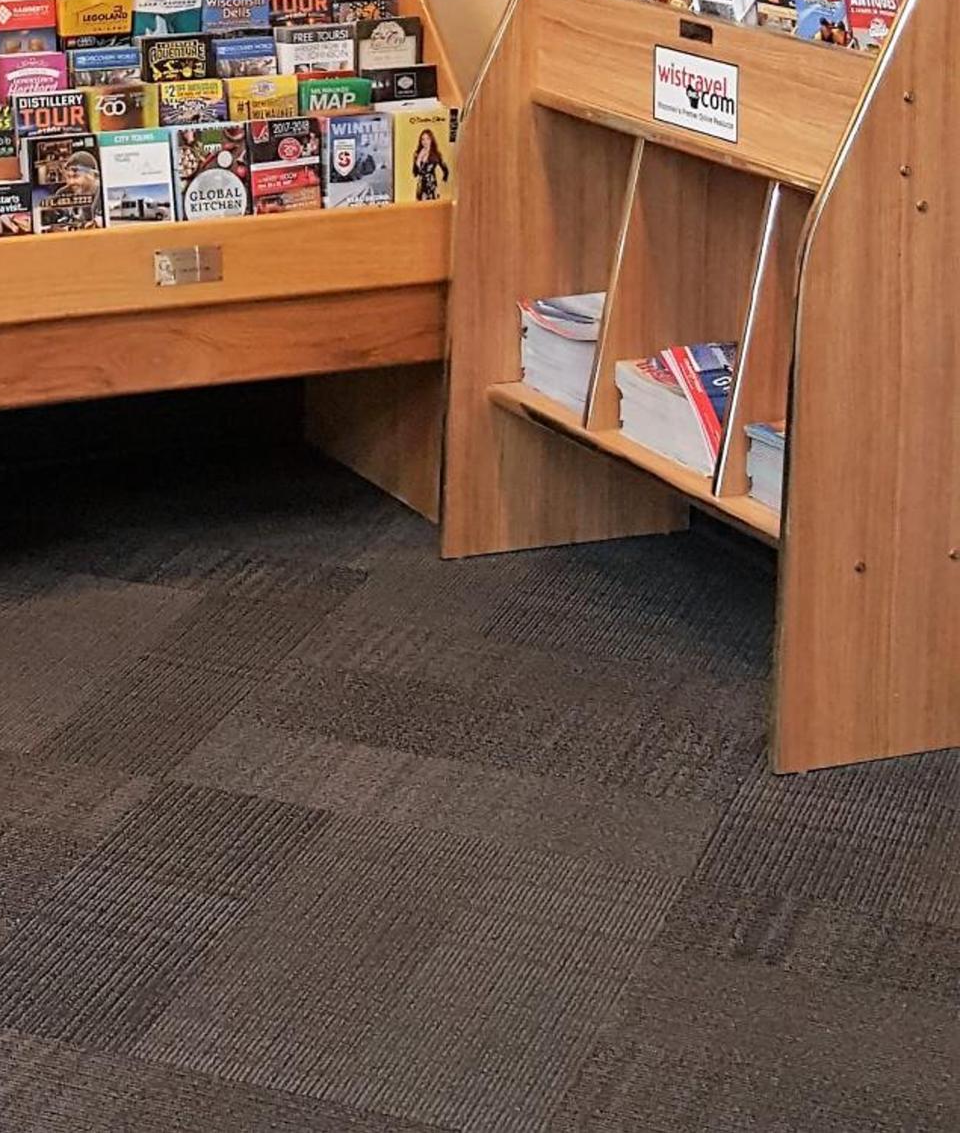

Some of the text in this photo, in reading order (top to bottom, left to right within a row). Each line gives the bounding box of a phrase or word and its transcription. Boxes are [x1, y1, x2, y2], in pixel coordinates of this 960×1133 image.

[83, 13, 128, 22] LEGOLAND
[223, 8, 251, 18] Dells
[293, 32, 314, 42] FREE
[658, 63, 727, 97] wistravel
[19, 95, 82, 109] DISTILLERY
[310, 93, 355, 110] MAP
[21, 107, 84, 127] TOUR
[190, 188, 241, 201] GLOBAL
[190, 200, 242, 212] KITCHEN
